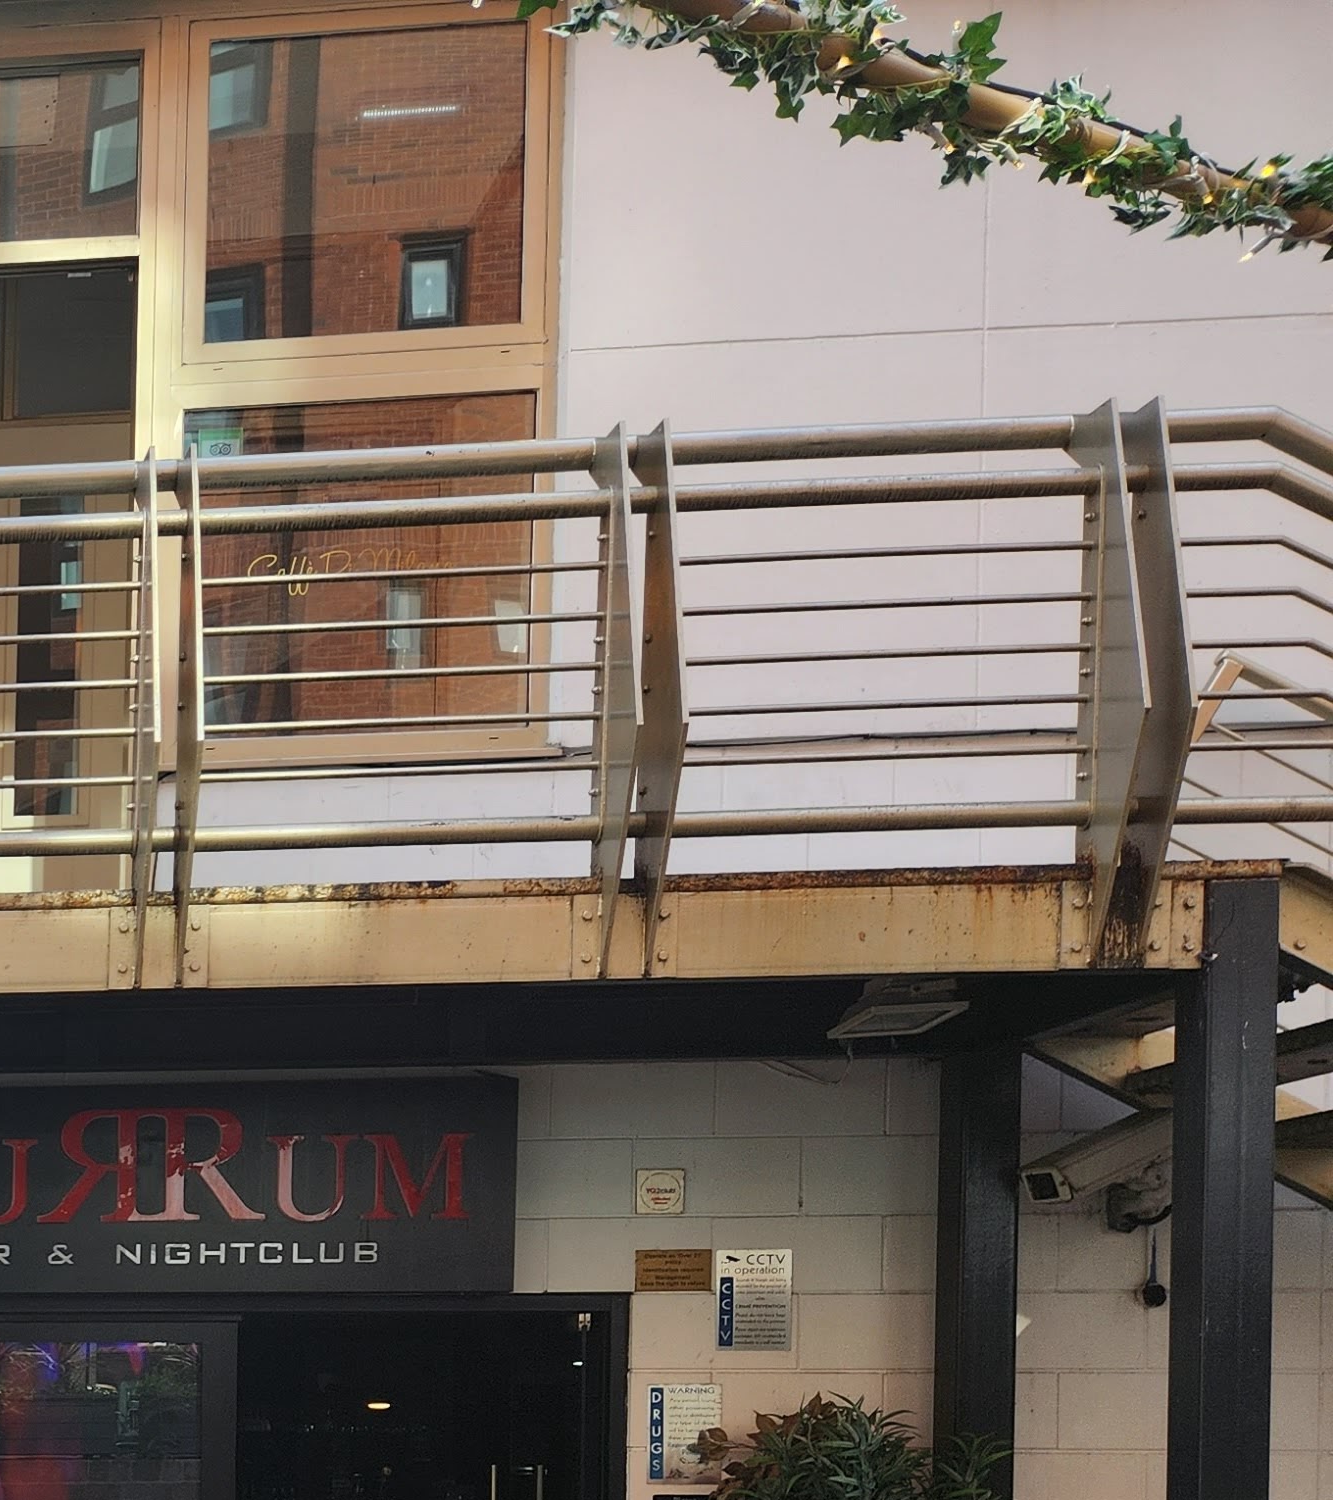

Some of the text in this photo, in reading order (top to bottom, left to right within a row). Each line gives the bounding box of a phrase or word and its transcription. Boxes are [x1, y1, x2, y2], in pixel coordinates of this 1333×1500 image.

[48, 1243, 74, 1266] &
[116, 1241, 379, 1267] NIGHTCLUB
[746, 1254, 786, 1265] CCTV
[721, 1266, 785, 1276] in operation
